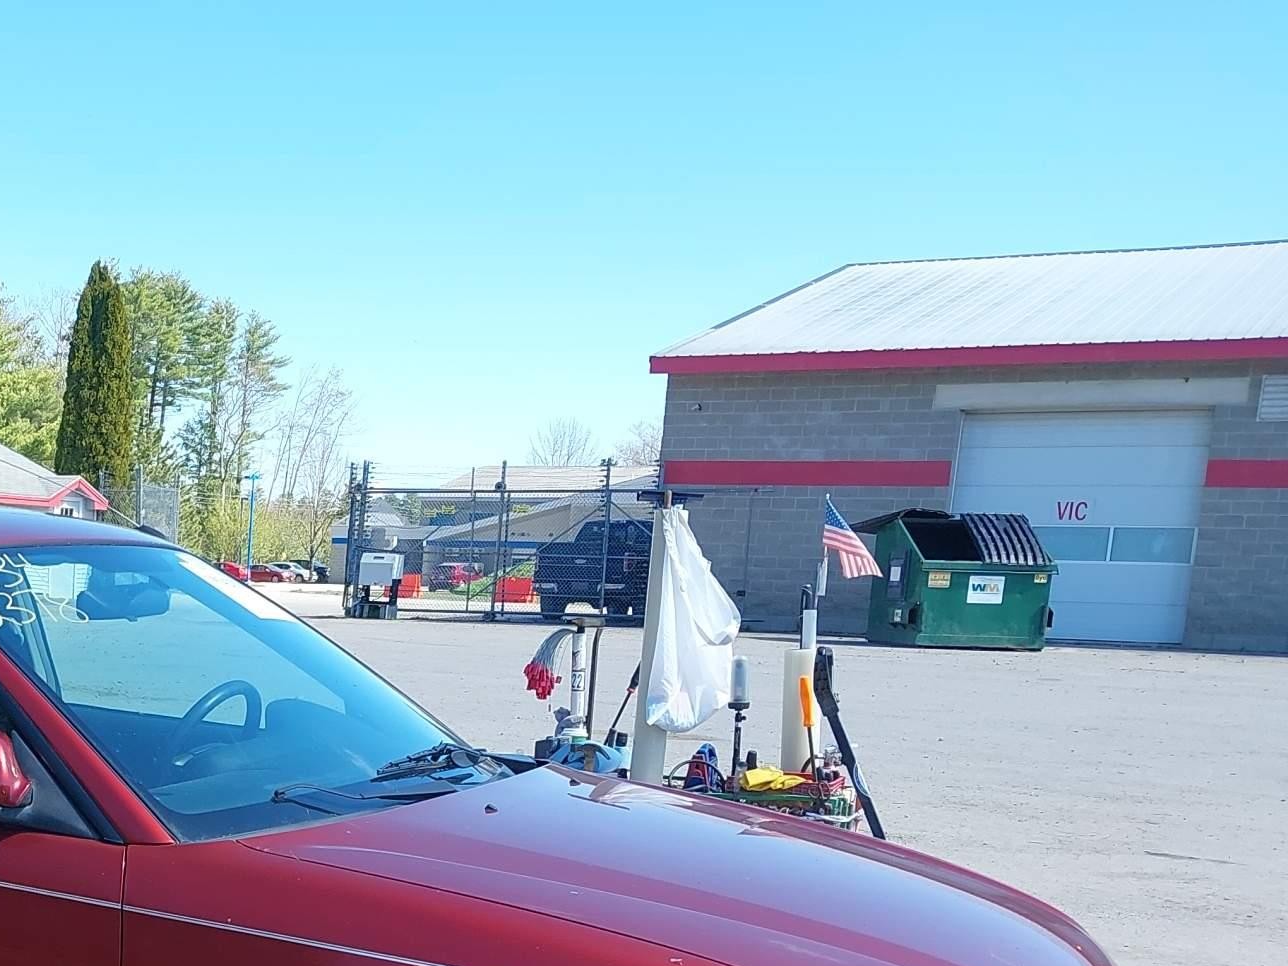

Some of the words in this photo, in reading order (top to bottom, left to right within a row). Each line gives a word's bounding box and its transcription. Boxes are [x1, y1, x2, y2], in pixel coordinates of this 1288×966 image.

[1056, 500, 1089, 521] VIC
[971, 583, 1000, 592] WM
[571, 673, 583, 688] 22
